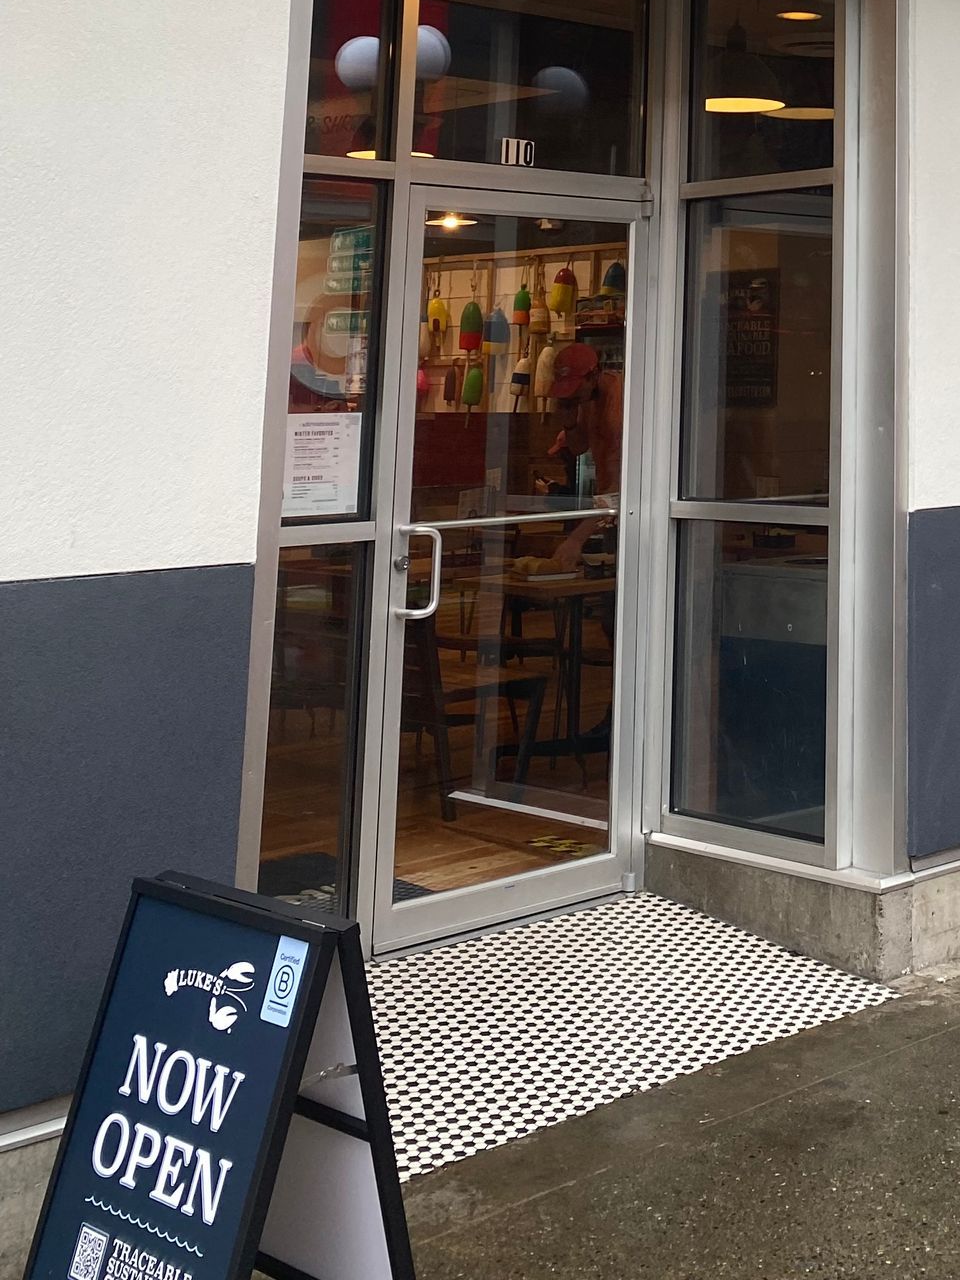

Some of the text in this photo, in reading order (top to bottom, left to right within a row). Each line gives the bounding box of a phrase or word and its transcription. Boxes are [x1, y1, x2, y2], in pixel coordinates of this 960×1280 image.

[505, 139, 534, 166] 110
[178, 970, 224, 996] LUKE'S
[278, 971, 290, 993] B
[118, 1034, 246, 1133] NOW
[92, 1112, 233, 1226] OPEN
